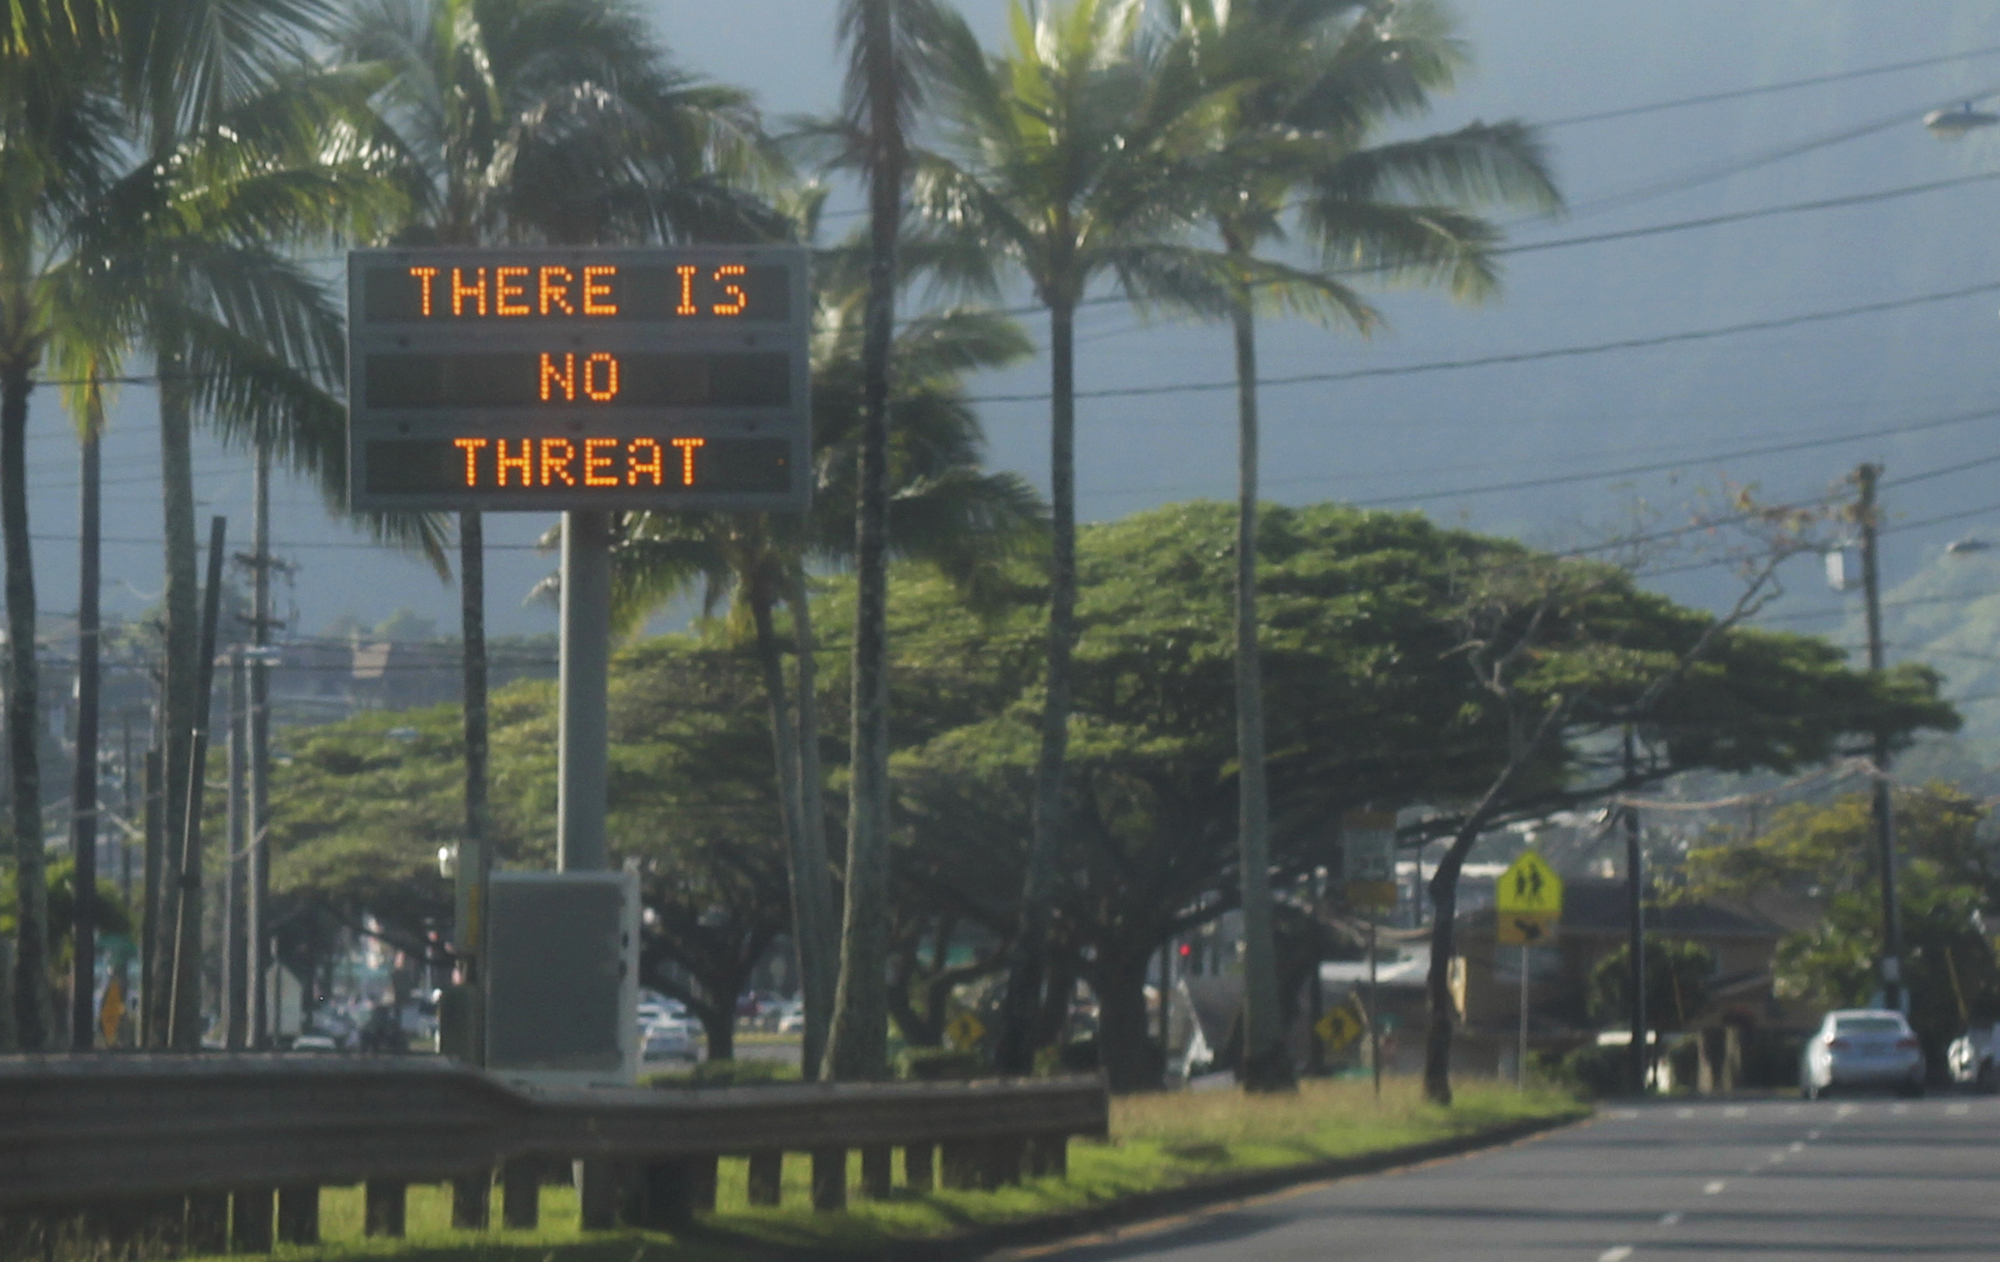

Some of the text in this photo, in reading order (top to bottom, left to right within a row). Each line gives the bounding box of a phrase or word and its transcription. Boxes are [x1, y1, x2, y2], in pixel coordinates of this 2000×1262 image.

[410, 266, 747, 316] THERE IS
[540, 353, 619, 401] NO
[454, 438, 705, 486] THREAT
